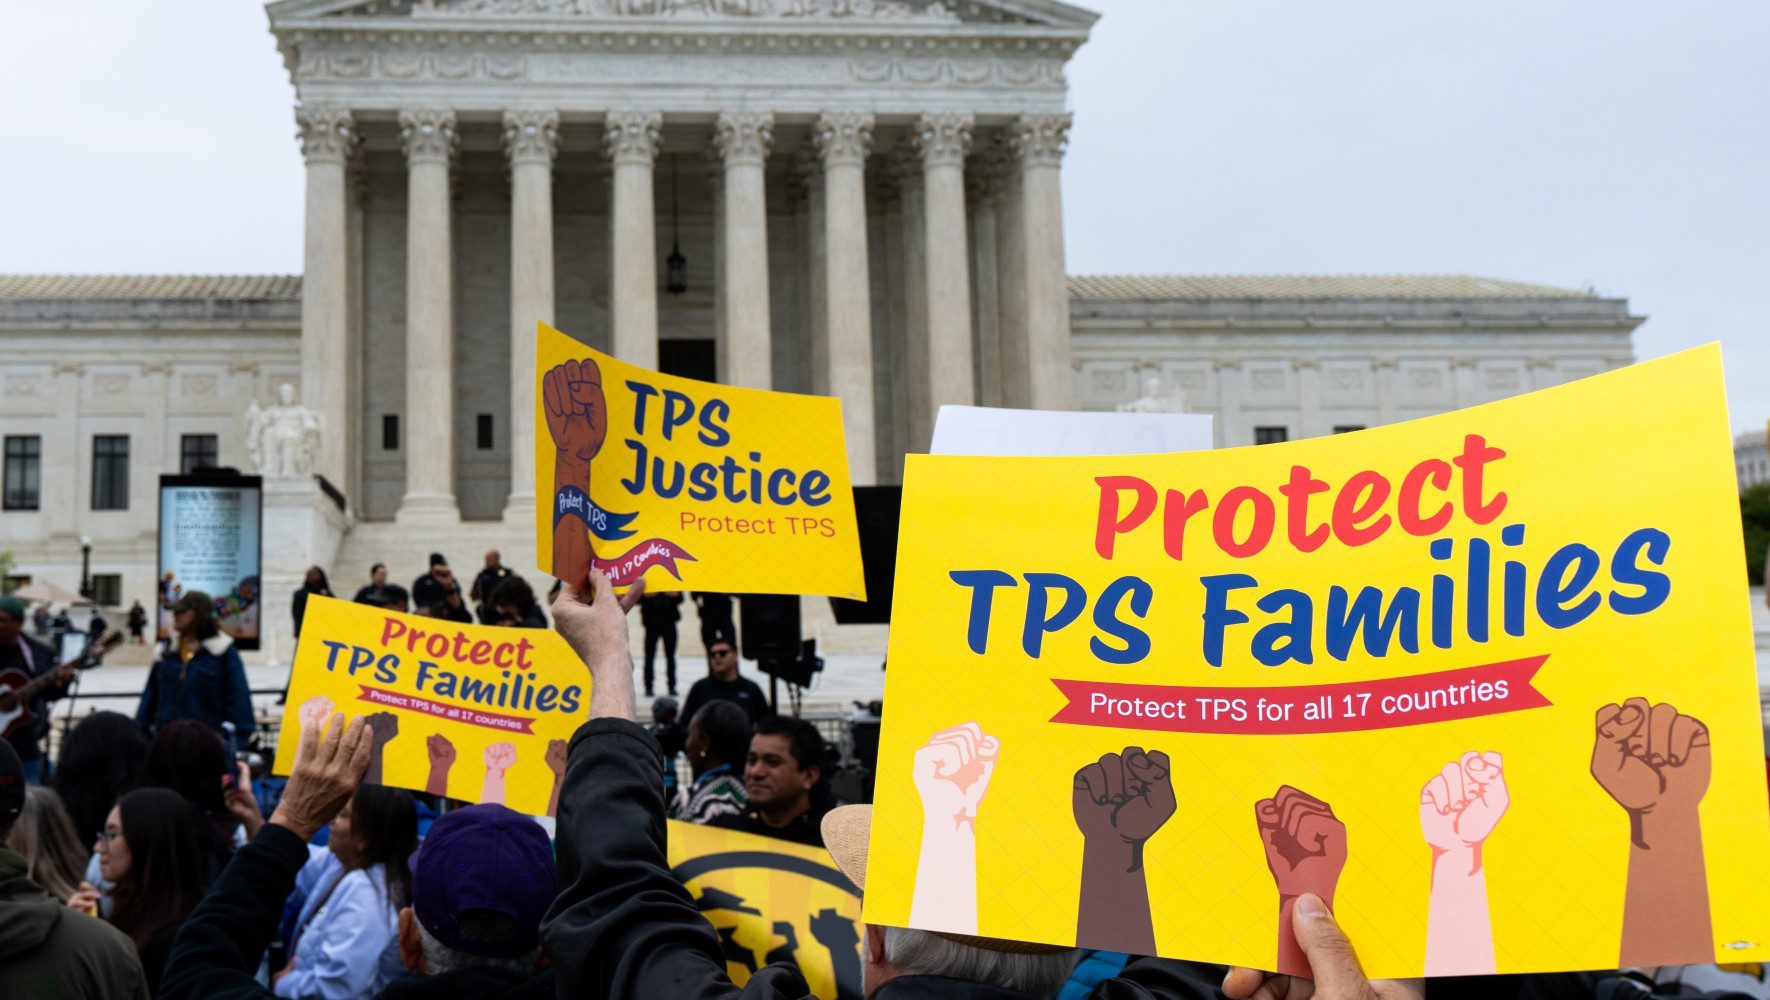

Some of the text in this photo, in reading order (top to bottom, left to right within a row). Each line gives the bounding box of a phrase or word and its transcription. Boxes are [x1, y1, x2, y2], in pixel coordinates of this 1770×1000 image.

[625, 380, 730, 447] TPS
[620, 438, 831, 507] Justice
[1094, 434, 1507, 561] Protect
[559, 490, 607, 531] Protect TPS
[680, 512, 836, 538] Protect TPS
[622, 562, 632, 575] 17
[634, 543, 670, 567] Countries
[948, 524, 1671, 667] TPS Families
[381, 617, 534, 670] Protect
[322, 640, 581, 713] TPS Families
[1090, 679, 1509, 721] Protect TPS for all 17 countries
[370, 690, 522, 730] Protect TPS for all 17 countries
